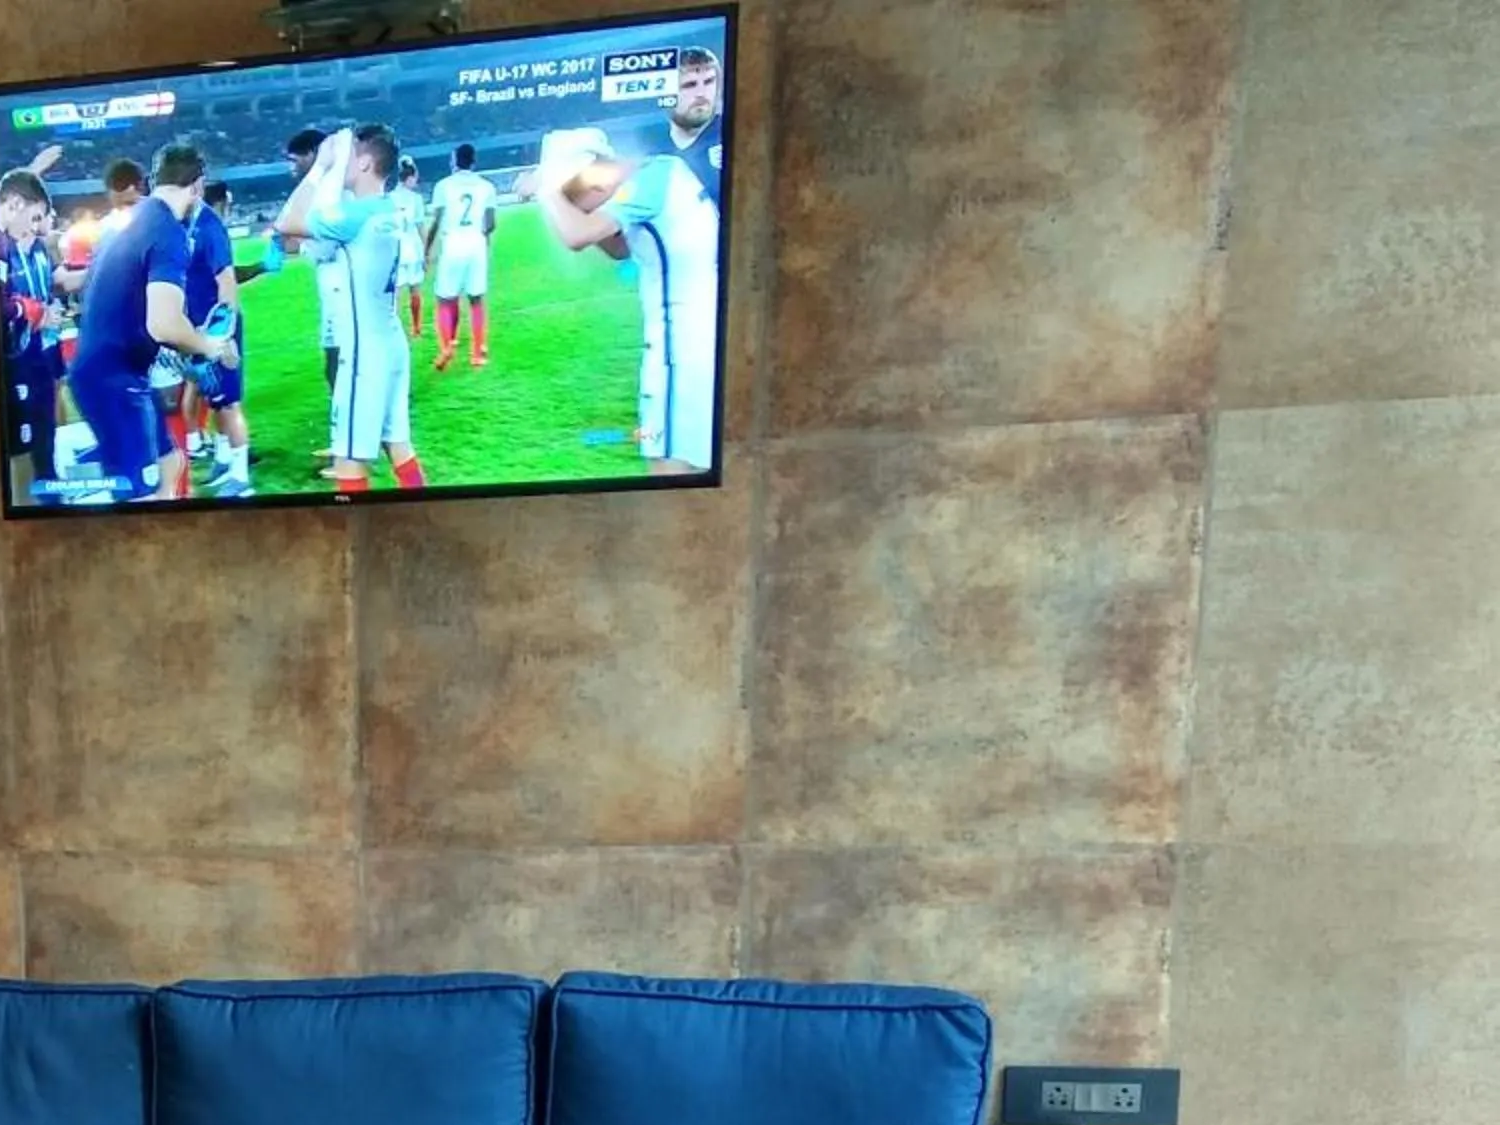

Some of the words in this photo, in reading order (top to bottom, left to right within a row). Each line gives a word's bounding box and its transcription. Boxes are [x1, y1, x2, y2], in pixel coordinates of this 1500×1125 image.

[459, 67, 492, 86] FIFA
[494, 63, 529, 82] U-17
[531, 61, 558, 78] WC
[560, 57, 596, 75] 2017
[609, 52, 674, 73] SONY
[475, 86, 516, 104] Brazil
[518, 86, 535, 99] vs
[537, 78, 597, 99] England
[615, 79, 650, 95] TEN
[654, 77, 667, 91] 2
[459, 192, 474, 227] 2
